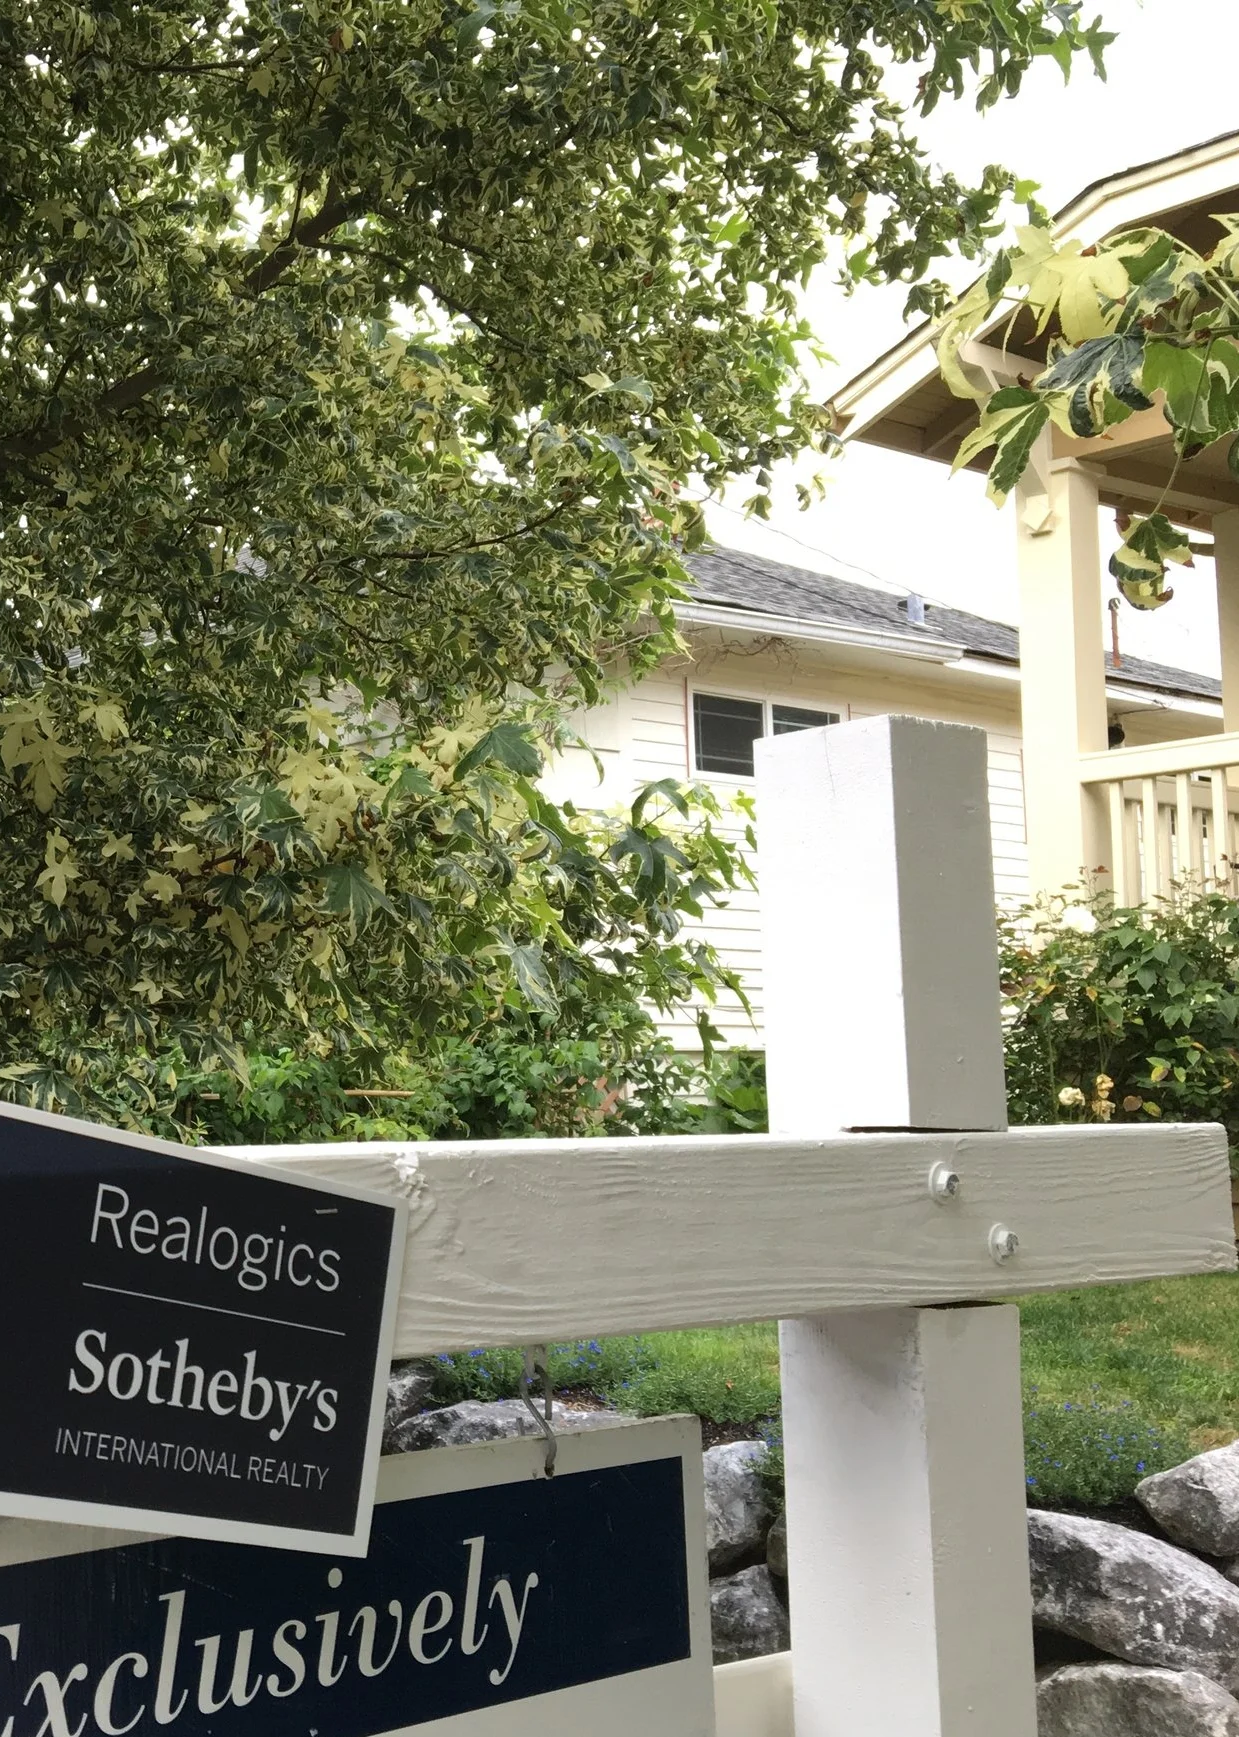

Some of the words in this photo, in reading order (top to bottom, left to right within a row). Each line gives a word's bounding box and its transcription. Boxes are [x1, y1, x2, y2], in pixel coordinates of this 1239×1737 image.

[90, 1182, 342, 1292] Realogics
[68, 1328, 339, 1441] Sotheby's
[55, 1427, 242, 1479] INTERNATIONAL
[247, 1455, 330, 1490] REALTY
